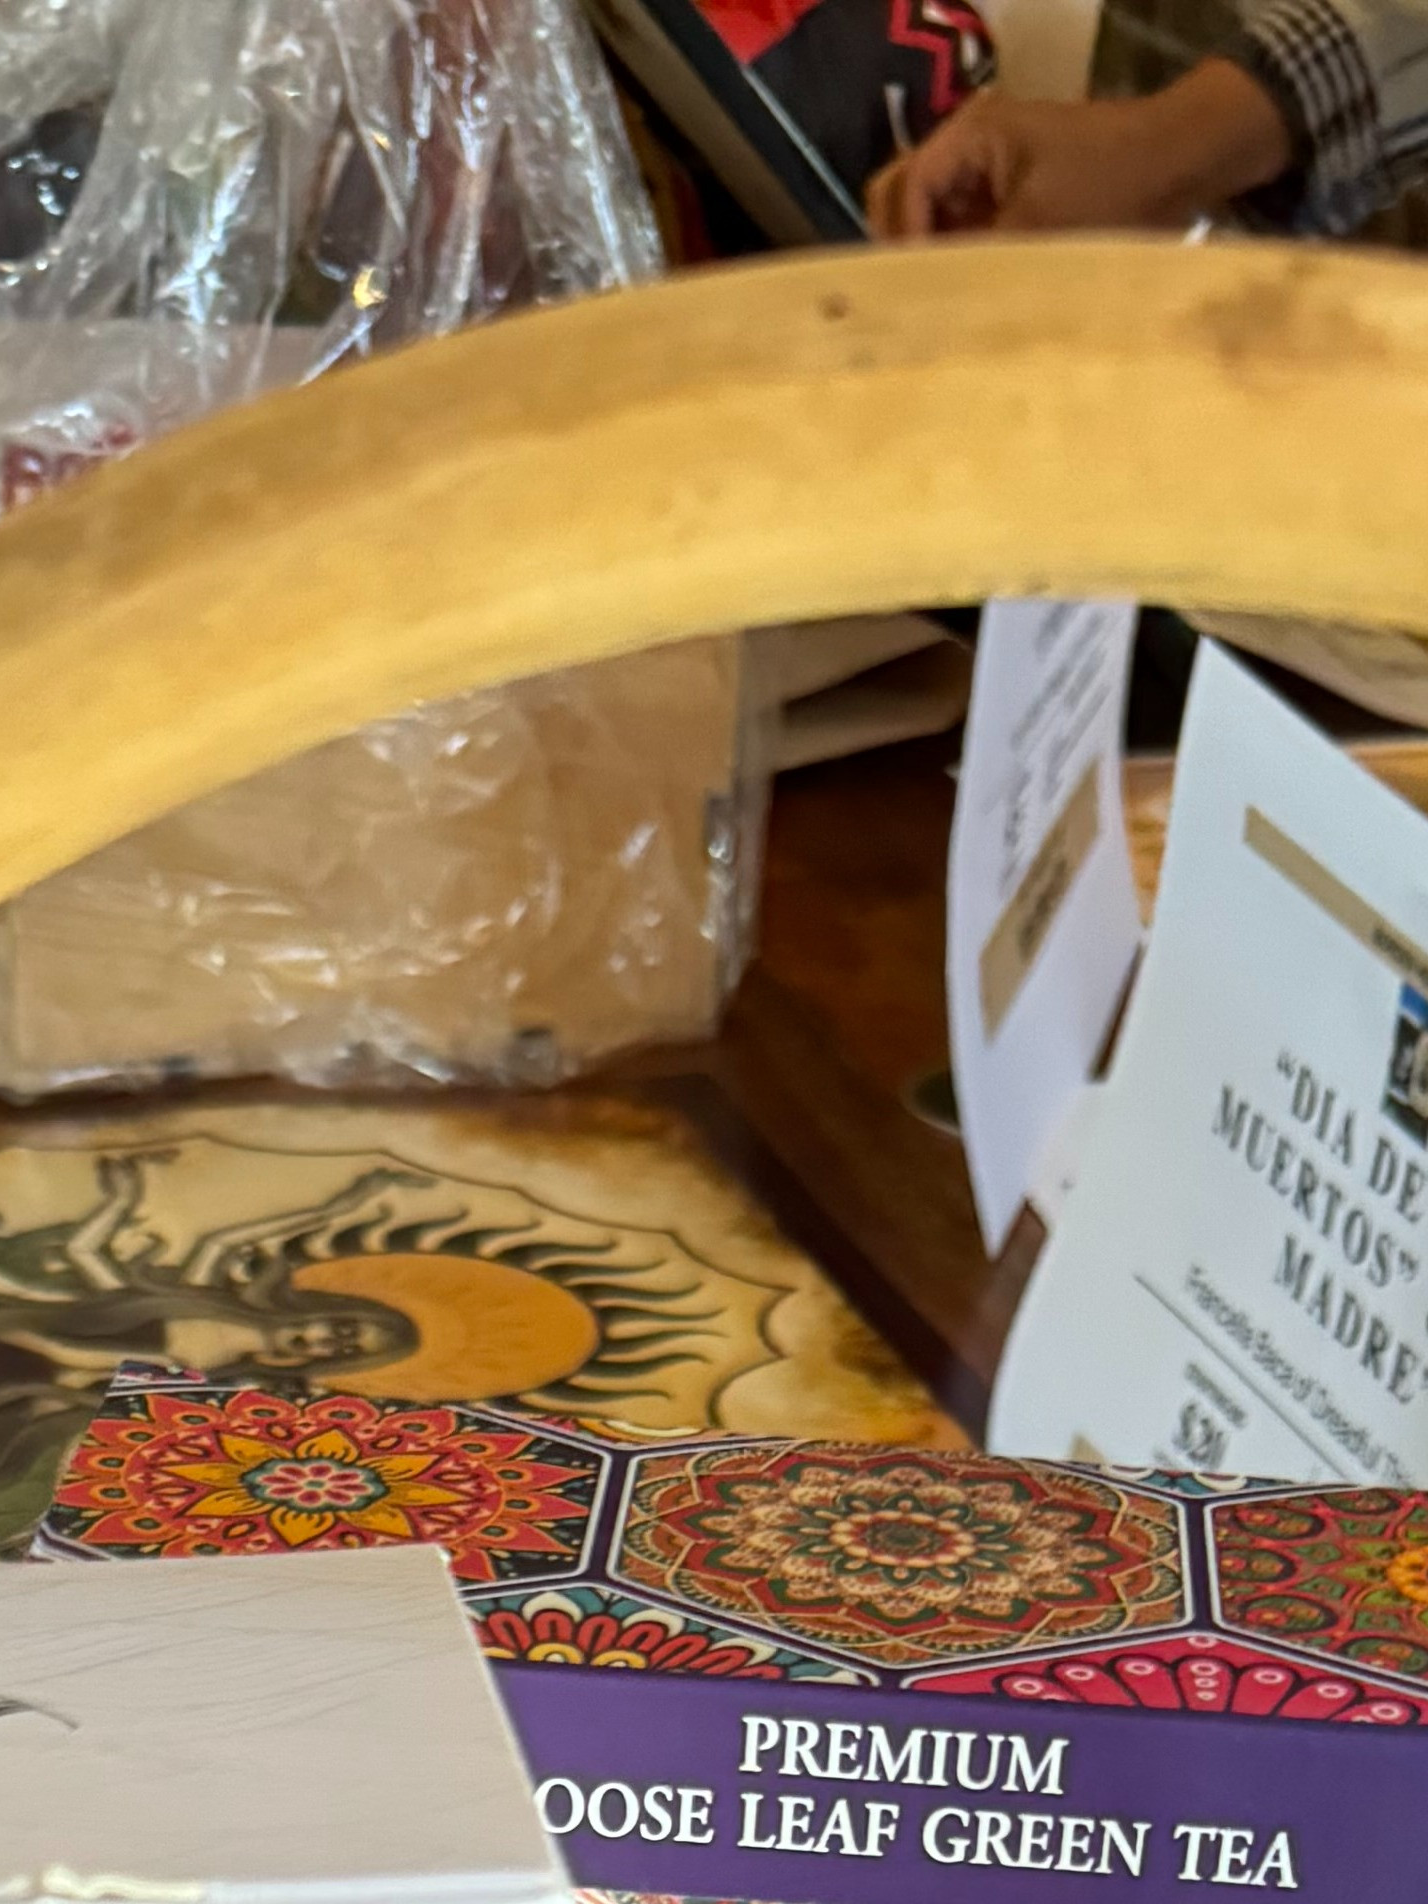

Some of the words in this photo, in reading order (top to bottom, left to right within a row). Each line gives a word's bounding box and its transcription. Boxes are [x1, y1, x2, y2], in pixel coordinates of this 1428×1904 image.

[1369, 1135, 1427, 1223] DE
[737, 1712, 1070, 1797] PREMIUM
[536, 1776, 716, 1847] OOSE
[736, 1790, 902, 1860] LEAF
[921, 1805, 1153, 1879] GREEN
[1173, 1822, 1299, 1890] TEA
